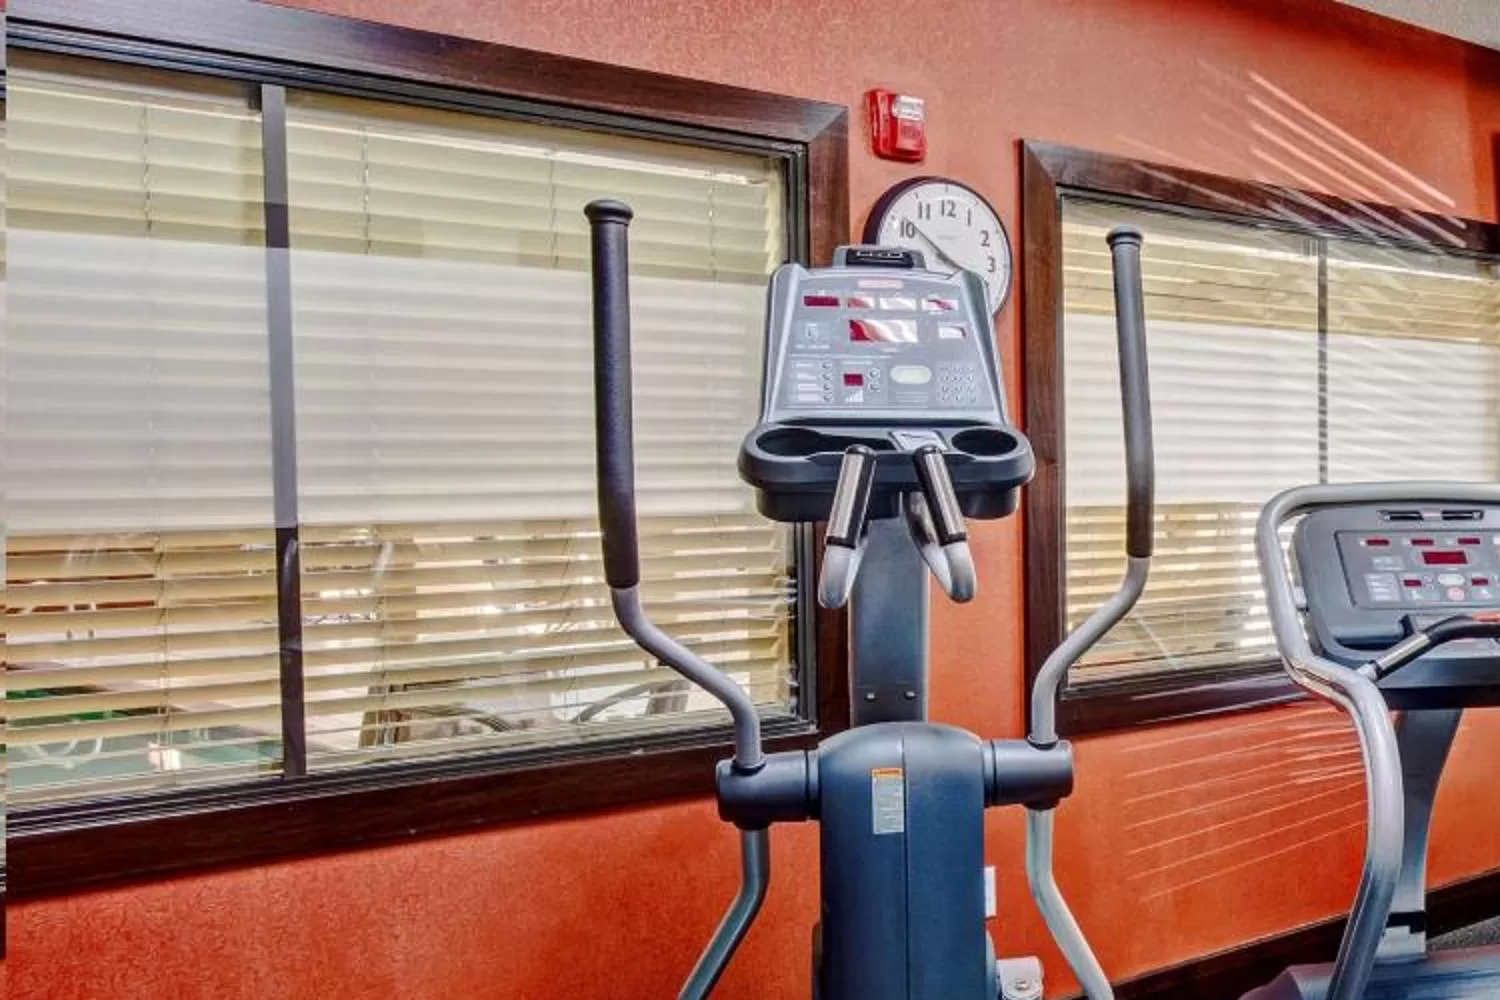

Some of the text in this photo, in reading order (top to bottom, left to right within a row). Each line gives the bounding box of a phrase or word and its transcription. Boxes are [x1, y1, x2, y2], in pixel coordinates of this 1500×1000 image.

[918, 201, 931, 220] 11
[941, 199, 957, 218] 12
[966, 208, 972, 227] 1
[900, 219, 916, 239] 10
[980, 229, 991, 247] 2
[987, 256, 997, 273] 3
